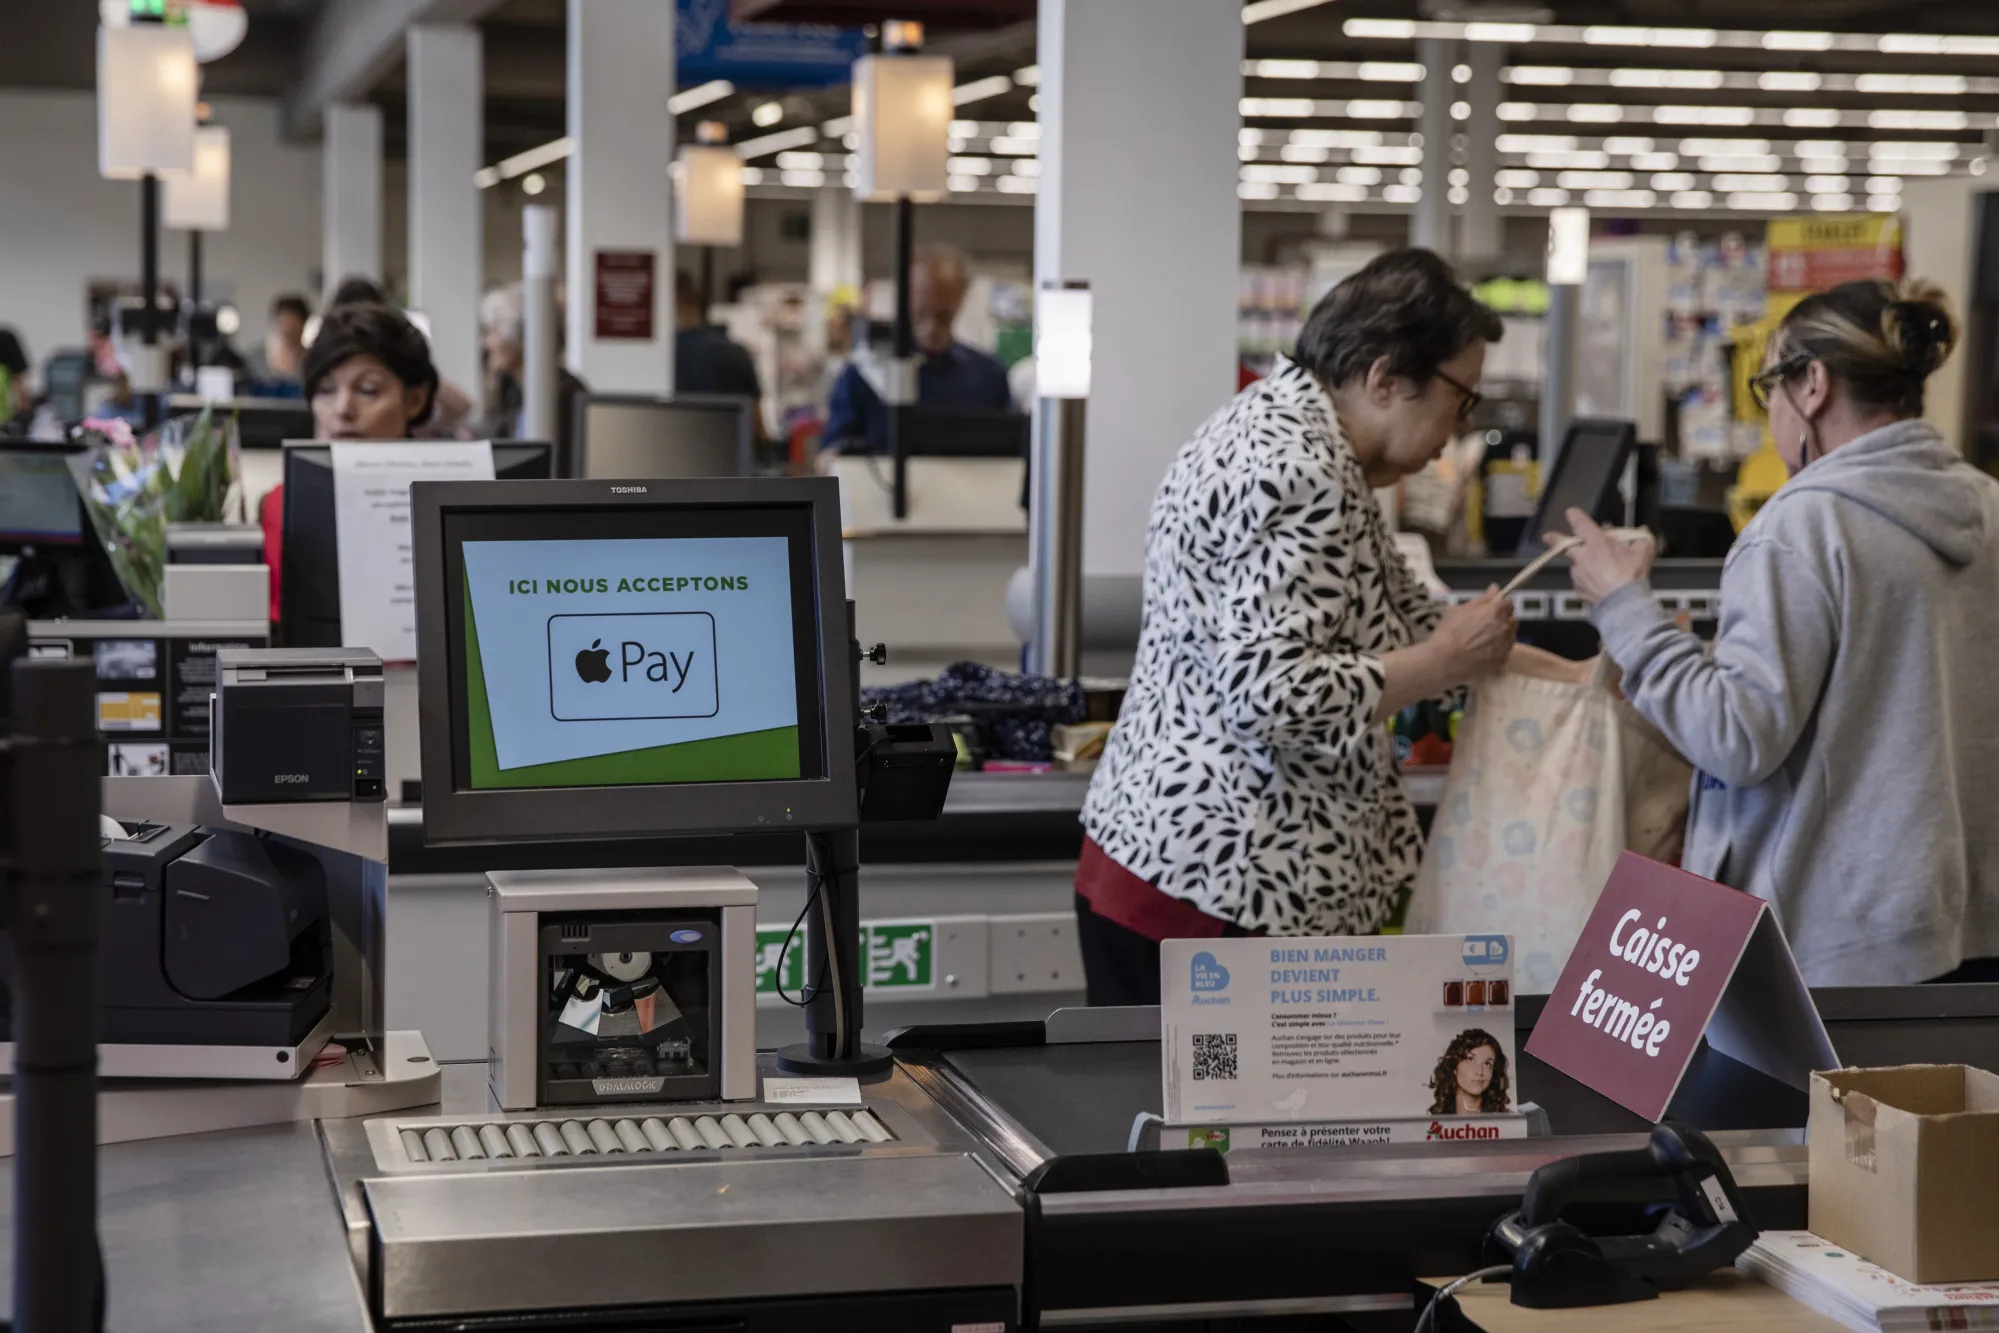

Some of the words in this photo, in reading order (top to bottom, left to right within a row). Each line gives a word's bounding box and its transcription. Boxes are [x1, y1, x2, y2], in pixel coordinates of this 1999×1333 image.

[610, 486, 648, 494] TOSHIBA
[509, 579, 538, 594] ICI
[546, 578, 609, 594] NOUS
[616, 575, 749, 593] ACCEPTONS
[621, 641, 695, 694] Pay
[274, 774, 309, 784] EPSON
[1609, 908, 1700, 987] Caisse
[1270, 949, 1308, 963] BIEN
[1314, 948, 1387, 962] MANGER
[1270, 969, 1340, 983] DEVIENT
[1191, 994, 1231, 1006] Auchan
[1270, 989, 1312, 1004] PLUS
[1316, 988, 1380, 1003] SIMPLE.
[1271, 1012, 1310, 1020] Consommer
[1570, 968, 1671, 1057] fermée
[1288, 1020, 1310, 1029] simple
[1346, 1032, 1372, 1041] produits
[1373, 1033, 1387, 1041] pour
[1271, 1042, 1309, 1050] composition
[1331, 1041, 1352, 1049] qualité
[1313, 1049, 1339, 1057] produits
[1340, 1048, 1378, 1056] sélectionnés
[1281, 1059, 1307, 1067] magasin
[1261, 1128, 1298, 1138] Pensez
[1300, 1127, 1307, 1136] à
[1310, 1126, 1360, 1138] présenter
[1363, 1126, 1391, 1135] votre
[1426, 1121, 1499, 1140] Auchan
[1261, 1140, 1288, 1149] carte
[1291, 1139, 1304, 1148] de
